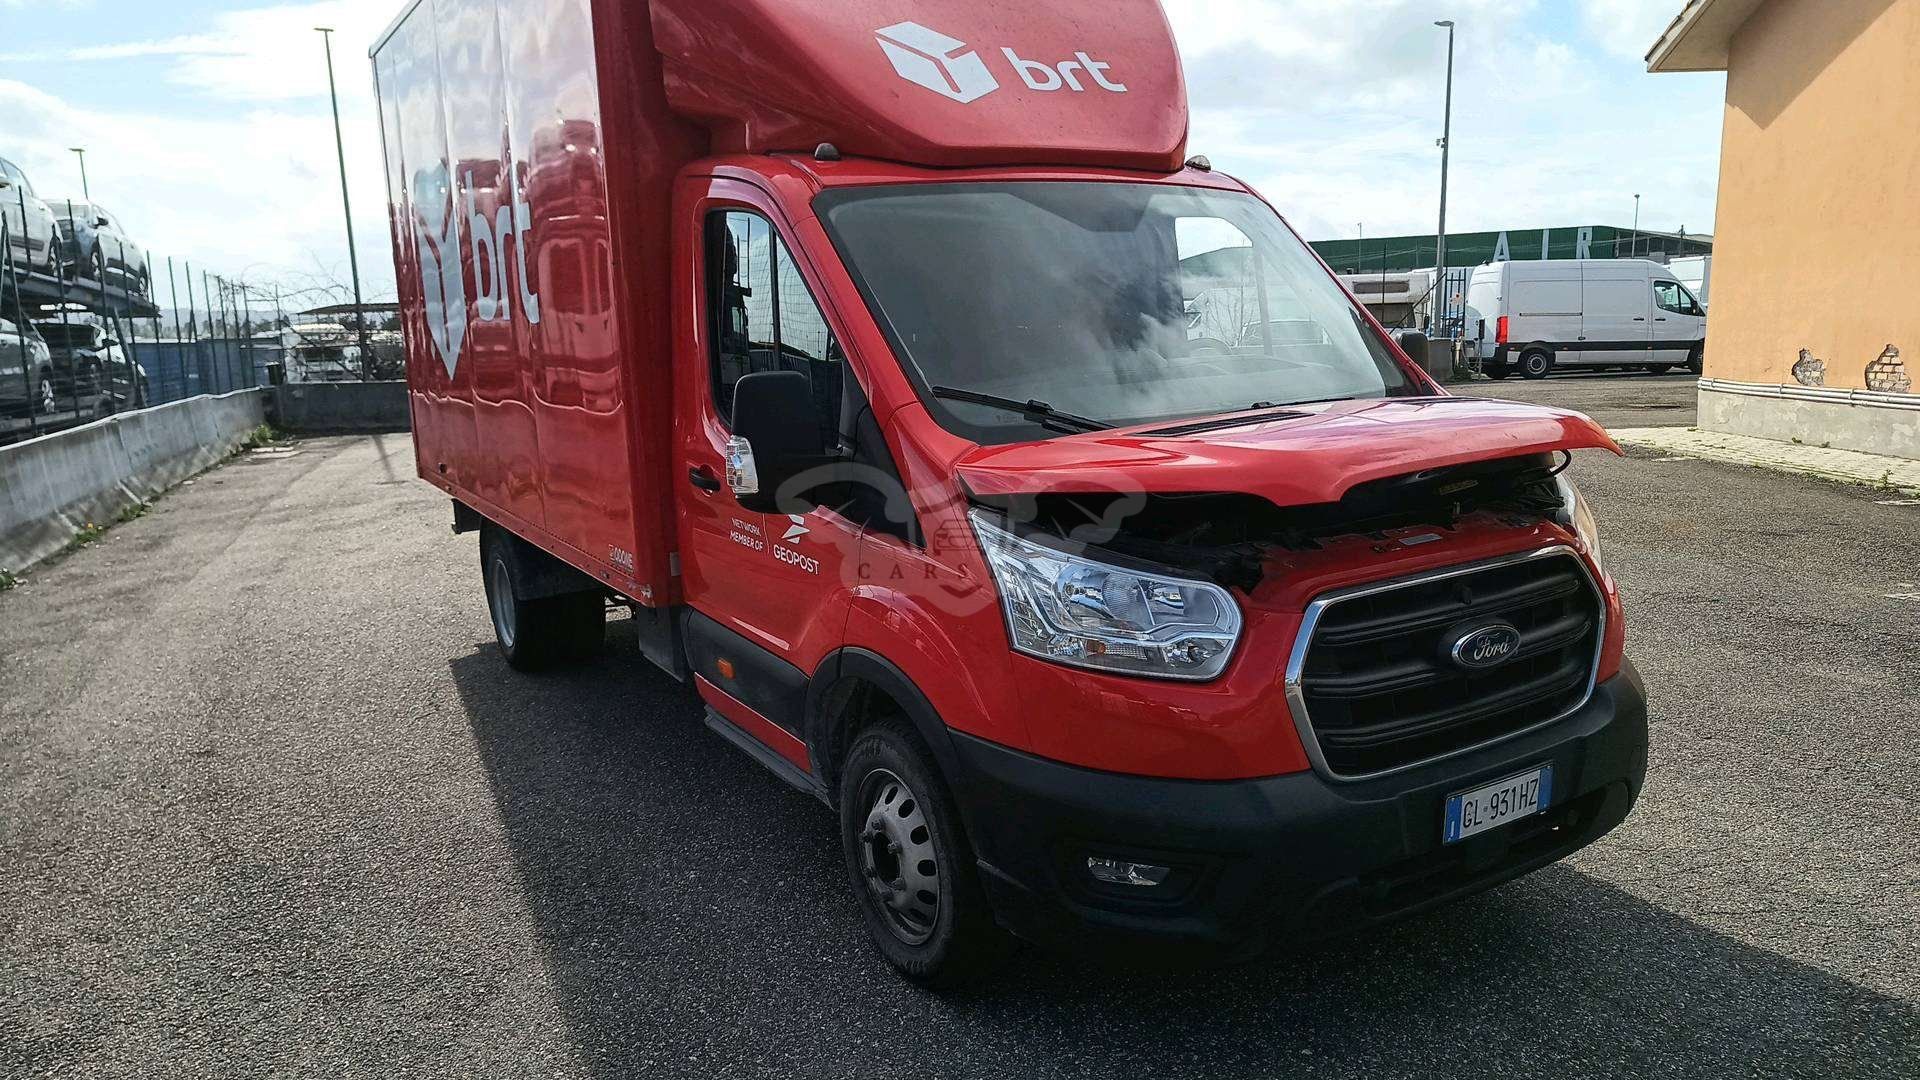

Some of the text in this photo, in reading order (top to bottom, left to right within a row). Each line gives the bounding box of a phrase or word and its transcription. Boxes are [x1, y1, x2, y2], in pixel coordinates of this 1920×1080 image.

[1000, 46, 1128, 92] brt
[465, 163, 540, 324] brt
[730, 530, 764, 552] MEMBER OF
[732, 517, 762, 537] NETWORK
[773, 544, 820, 575] GEOPOST
[1473, 632, 1511, 662] Ford
[1463, 778, 1540, 829] GL 931HZ
